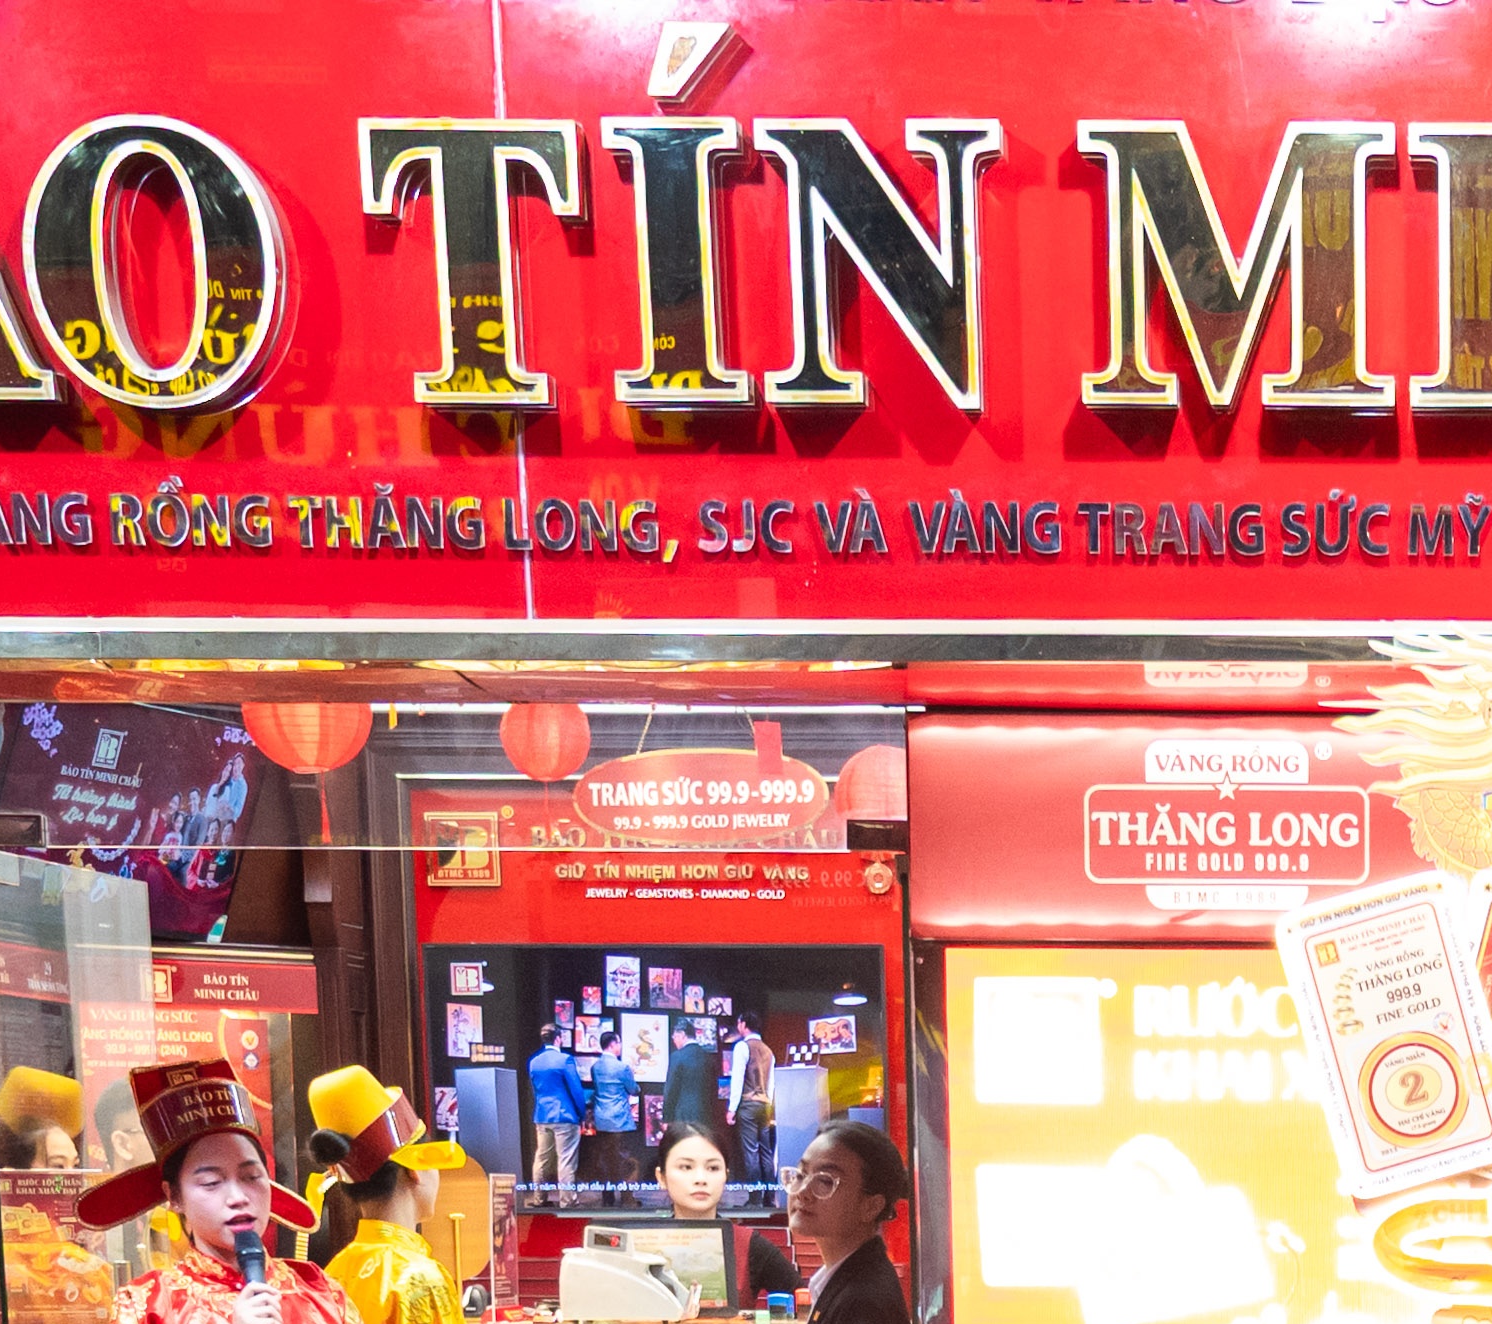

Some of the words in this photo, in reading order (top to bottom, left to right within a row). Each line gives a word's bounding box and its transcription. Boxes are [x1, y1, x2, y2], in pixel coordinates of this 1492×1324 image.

[358, 22, 1004, 414] TÍN
[110, 474, 272, 548] RỒNG
[289, 481, 486, 552] THĂNG
[506, 497, 680, 562] LONG,
[699, 498, 794, 554] SJC
[816, 488, 888, 555] VÀ
[910, 488, 1061, 556] VÀNG
[1078, 500, 1266, 557] TRANG
[1280, 488, 1391, 559] SỨC
[1155, 749, 1222, 772] VÀNG
[1232, 746, 1300, 773] RỒNG
[588, 782, 658, 807] TRANG
[663, 776, 703, 806] SỨC
[613, 816, 642, 830] 99.9
[653, 815, 689, 829] 999.9
[691, 814, 729, 829] GOLD
[732, 813, 790, 829] JEWELRY
[1090, 803, 1236, 846] THĂNG
[1248, 812, 1360, 847] LONG
[1146, 853, 1187, 871] FINE
[1198, 853, 1244, 872] GOLD
[1254, 854, 1310, 872] 999.9
[585, 888, 630, 899] JEWELRY
[635, 888, 694, 899] GEMSTONES
[701, 888, 750, 899] DIAMOND
[756, 889, 786, 900] GOLD
[203, 971, 228, 987] BẢO
[231, 972, 250, 987] TÍN
[1357, 969, 1404, 994] THĂNG
[1406, 957, 1442, 982] LONG
[194, 985, 225, 1000] MINH
[227, 984, 260, 1001] CHÂU
[1386, 983, 1422, 1004] 999.9
[1376, 1008, 1406, 1026] FINE
[1407, 997, 1442, 1016] GOLD
[1399, 1069, 1430, 1106] 2
